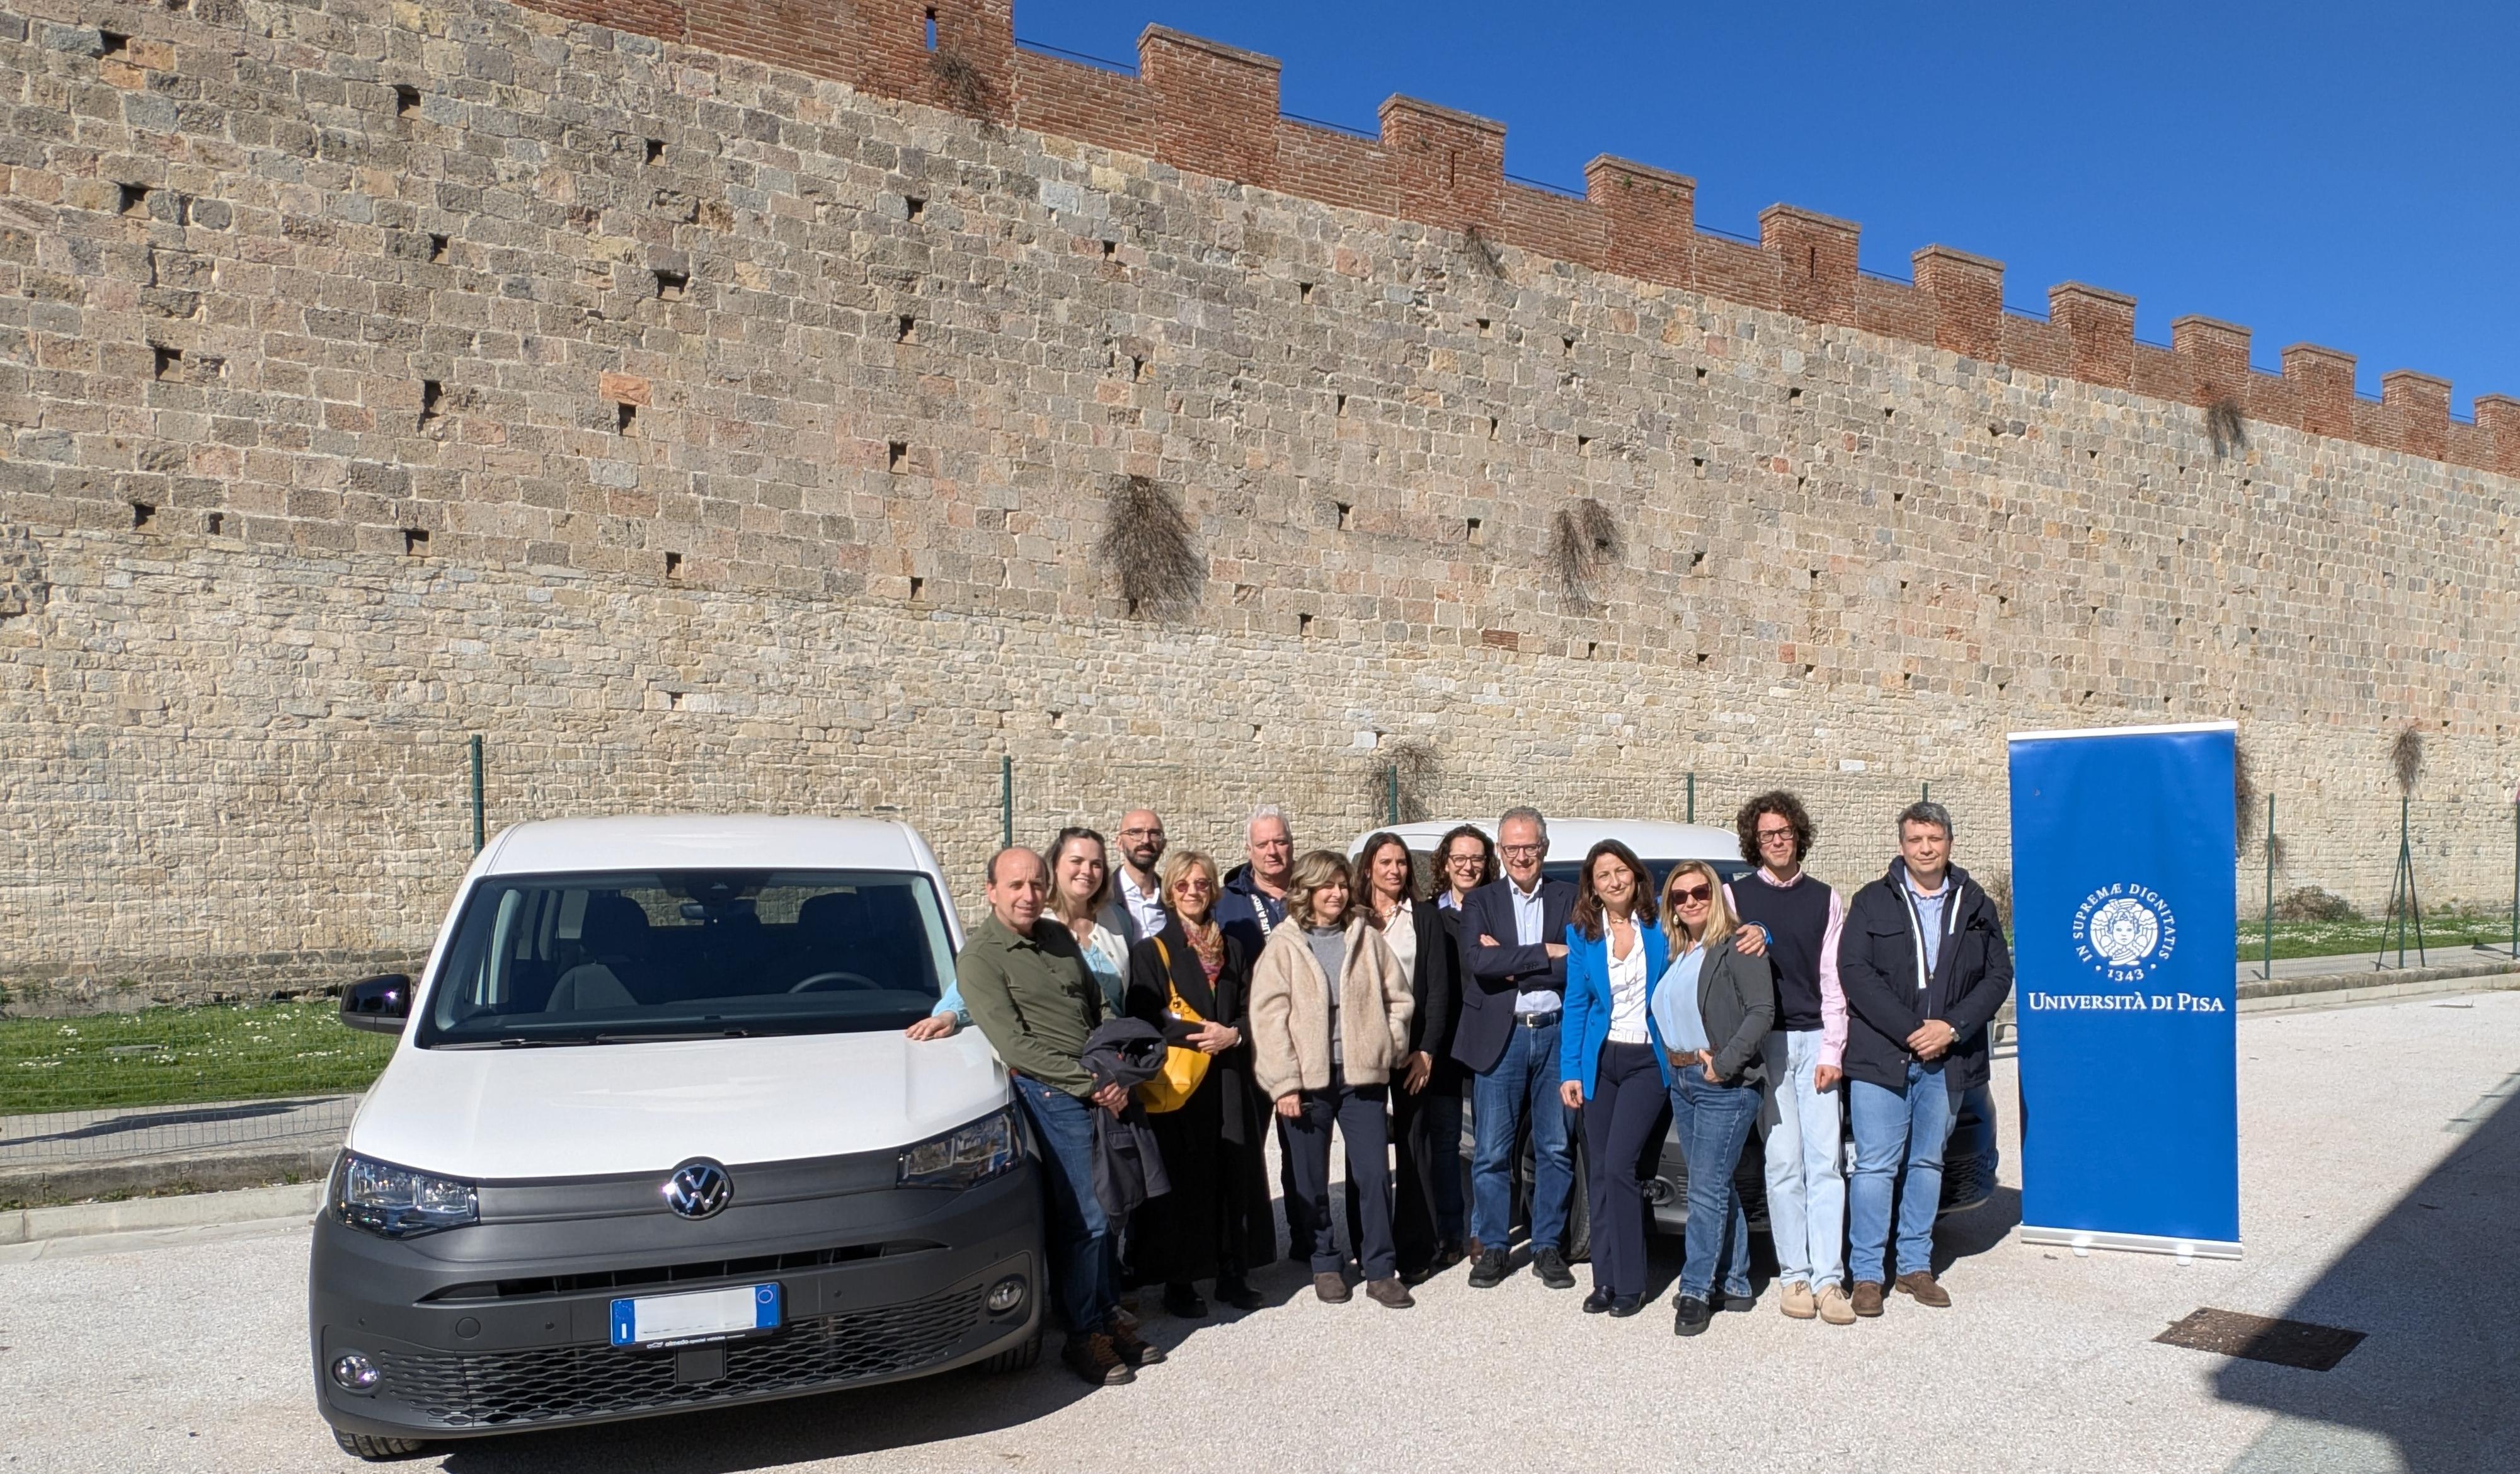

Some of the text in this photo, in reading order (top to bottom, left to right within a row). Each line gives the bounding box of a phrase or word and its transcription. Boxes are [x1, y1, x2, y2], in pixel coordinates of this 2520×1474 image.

[2075, 945, 2093, 963] IN
[2129, 883, 2176, 960] DIGNITATIS
[2107, 969, 2145, 981] 1343
[2151, 995, 2173, 1010] DI
[2177, 992, 2226, 1012] PISA
